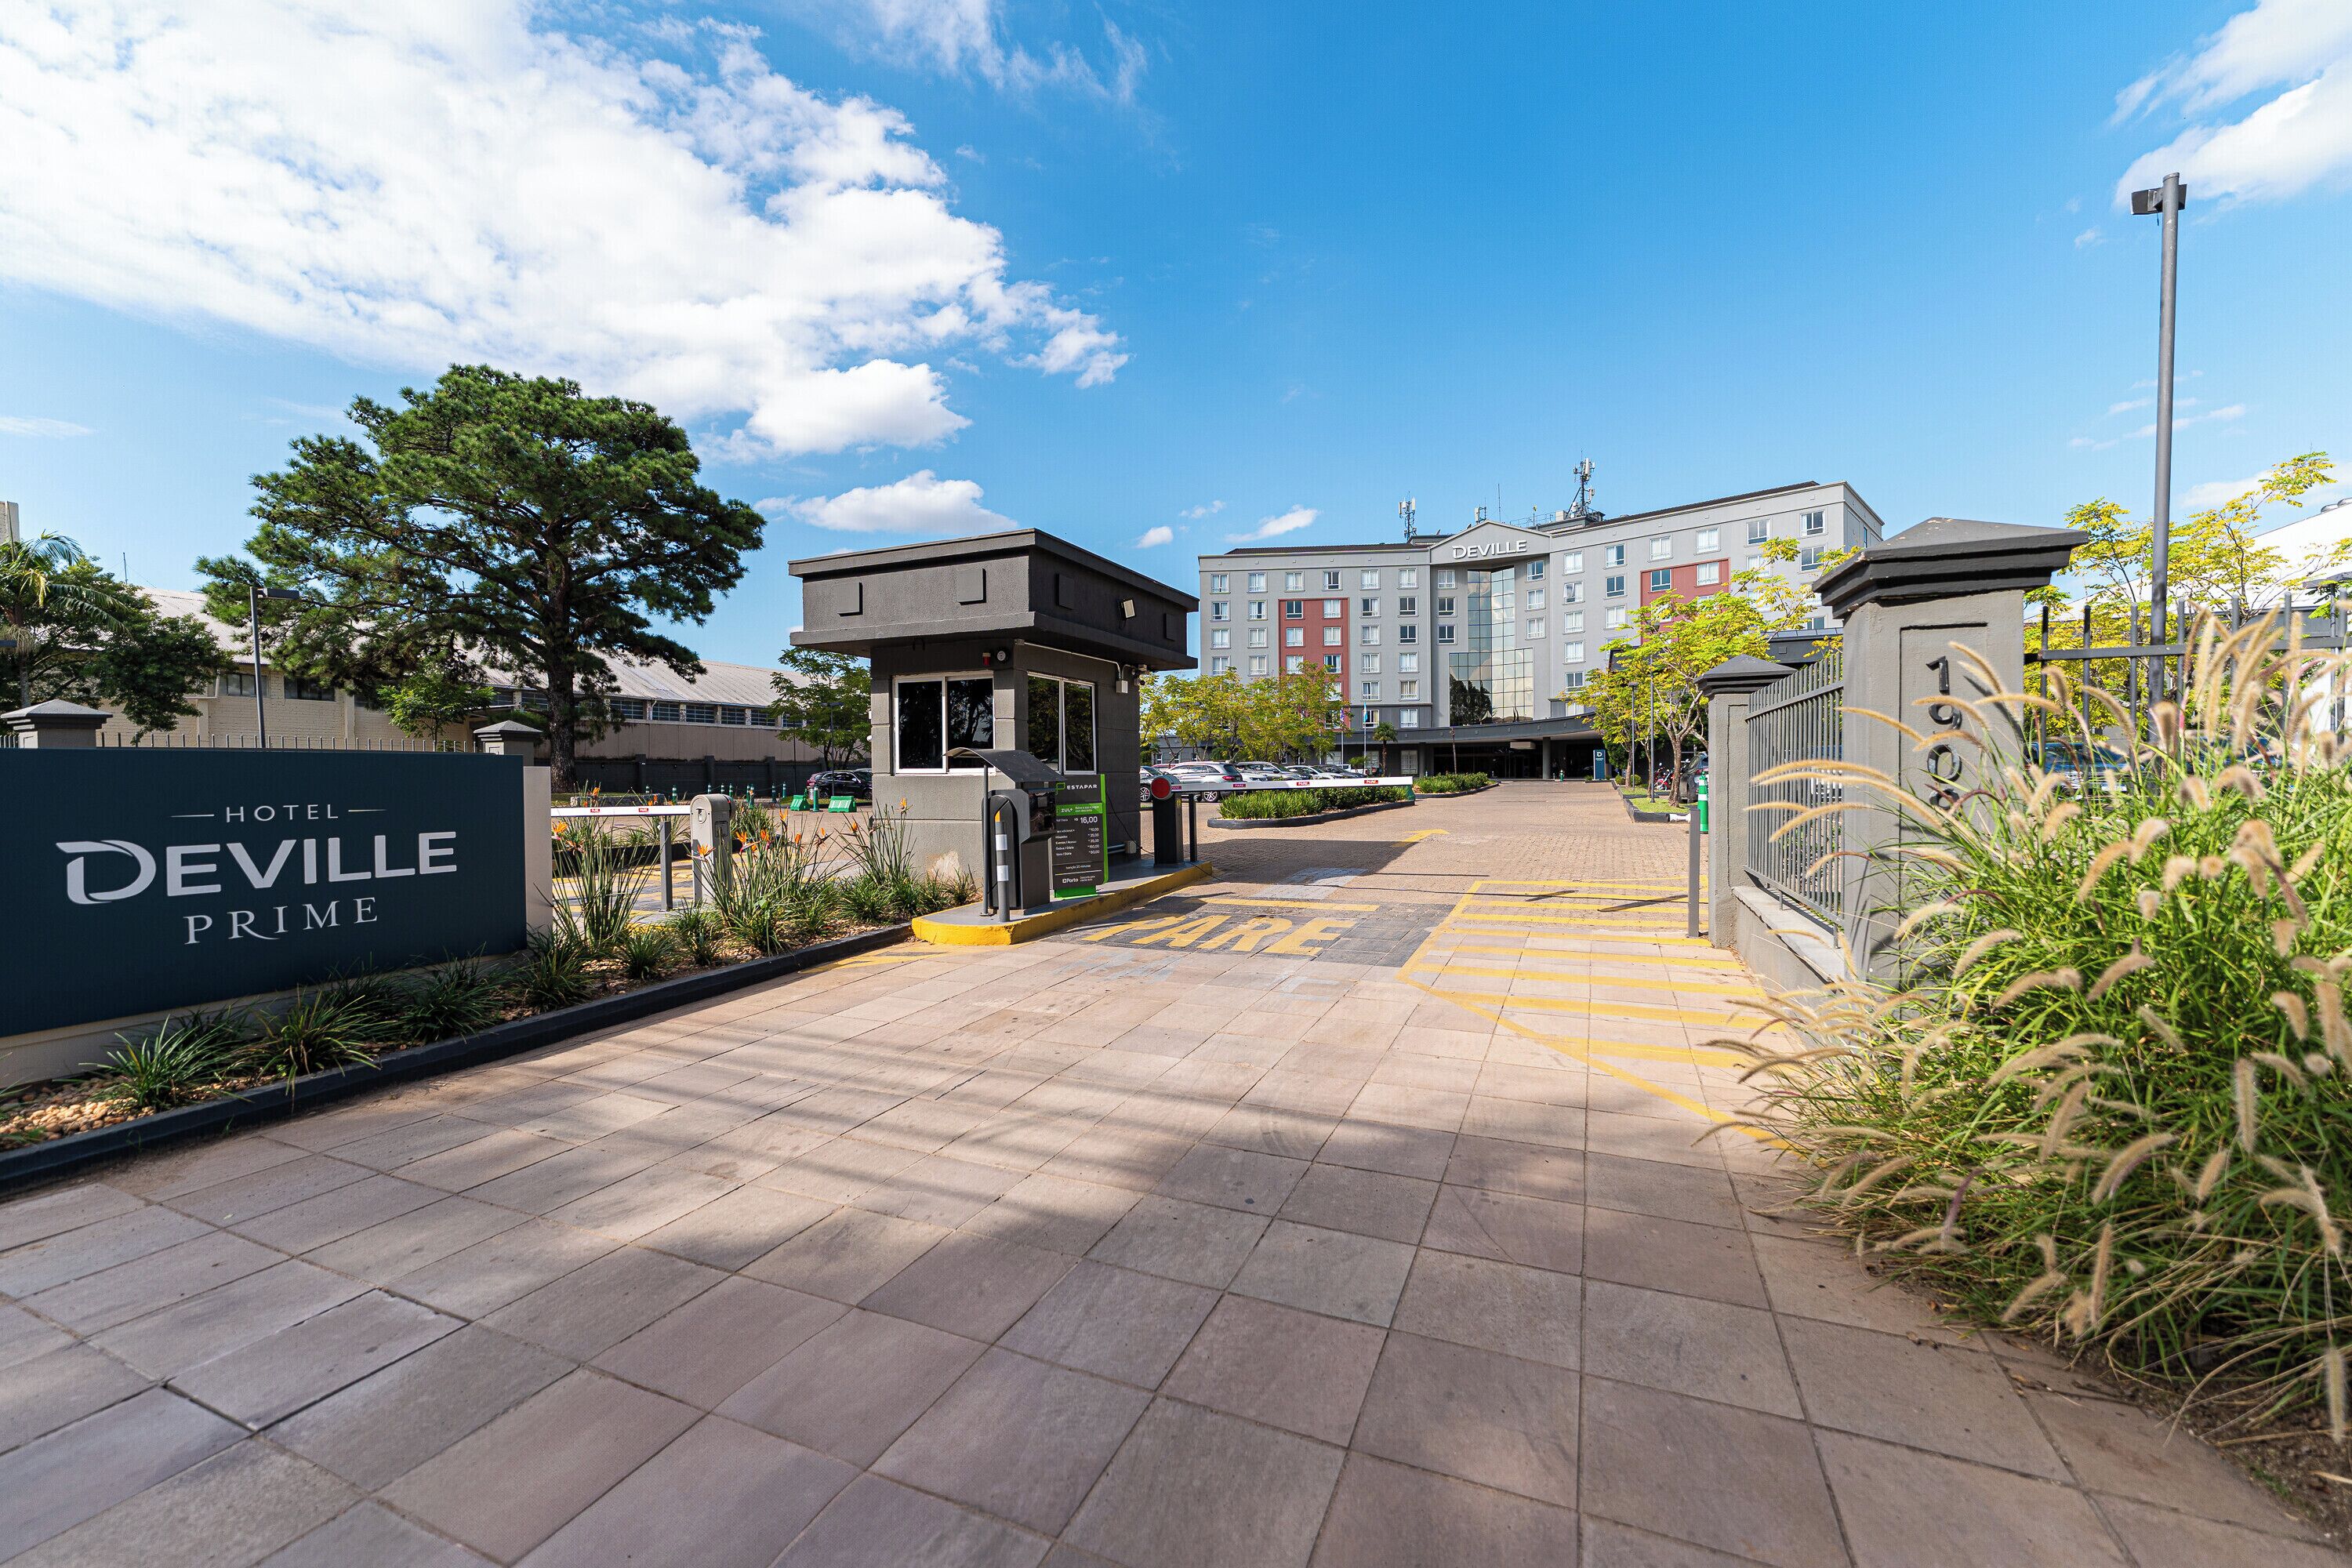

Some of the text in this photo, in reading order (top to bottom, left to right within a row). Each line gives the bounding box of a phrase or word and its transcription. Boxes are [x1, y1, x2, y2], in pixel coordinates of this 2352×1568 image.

[1452, 539, 1527, 560] DEVILLE
[225, 804, 339, 824] HOTEL
[56, 831, 458, 905] DEVILLE
[183, 897, 378, 945] PRIME
[1081, 913, 1358, 956] PARE
